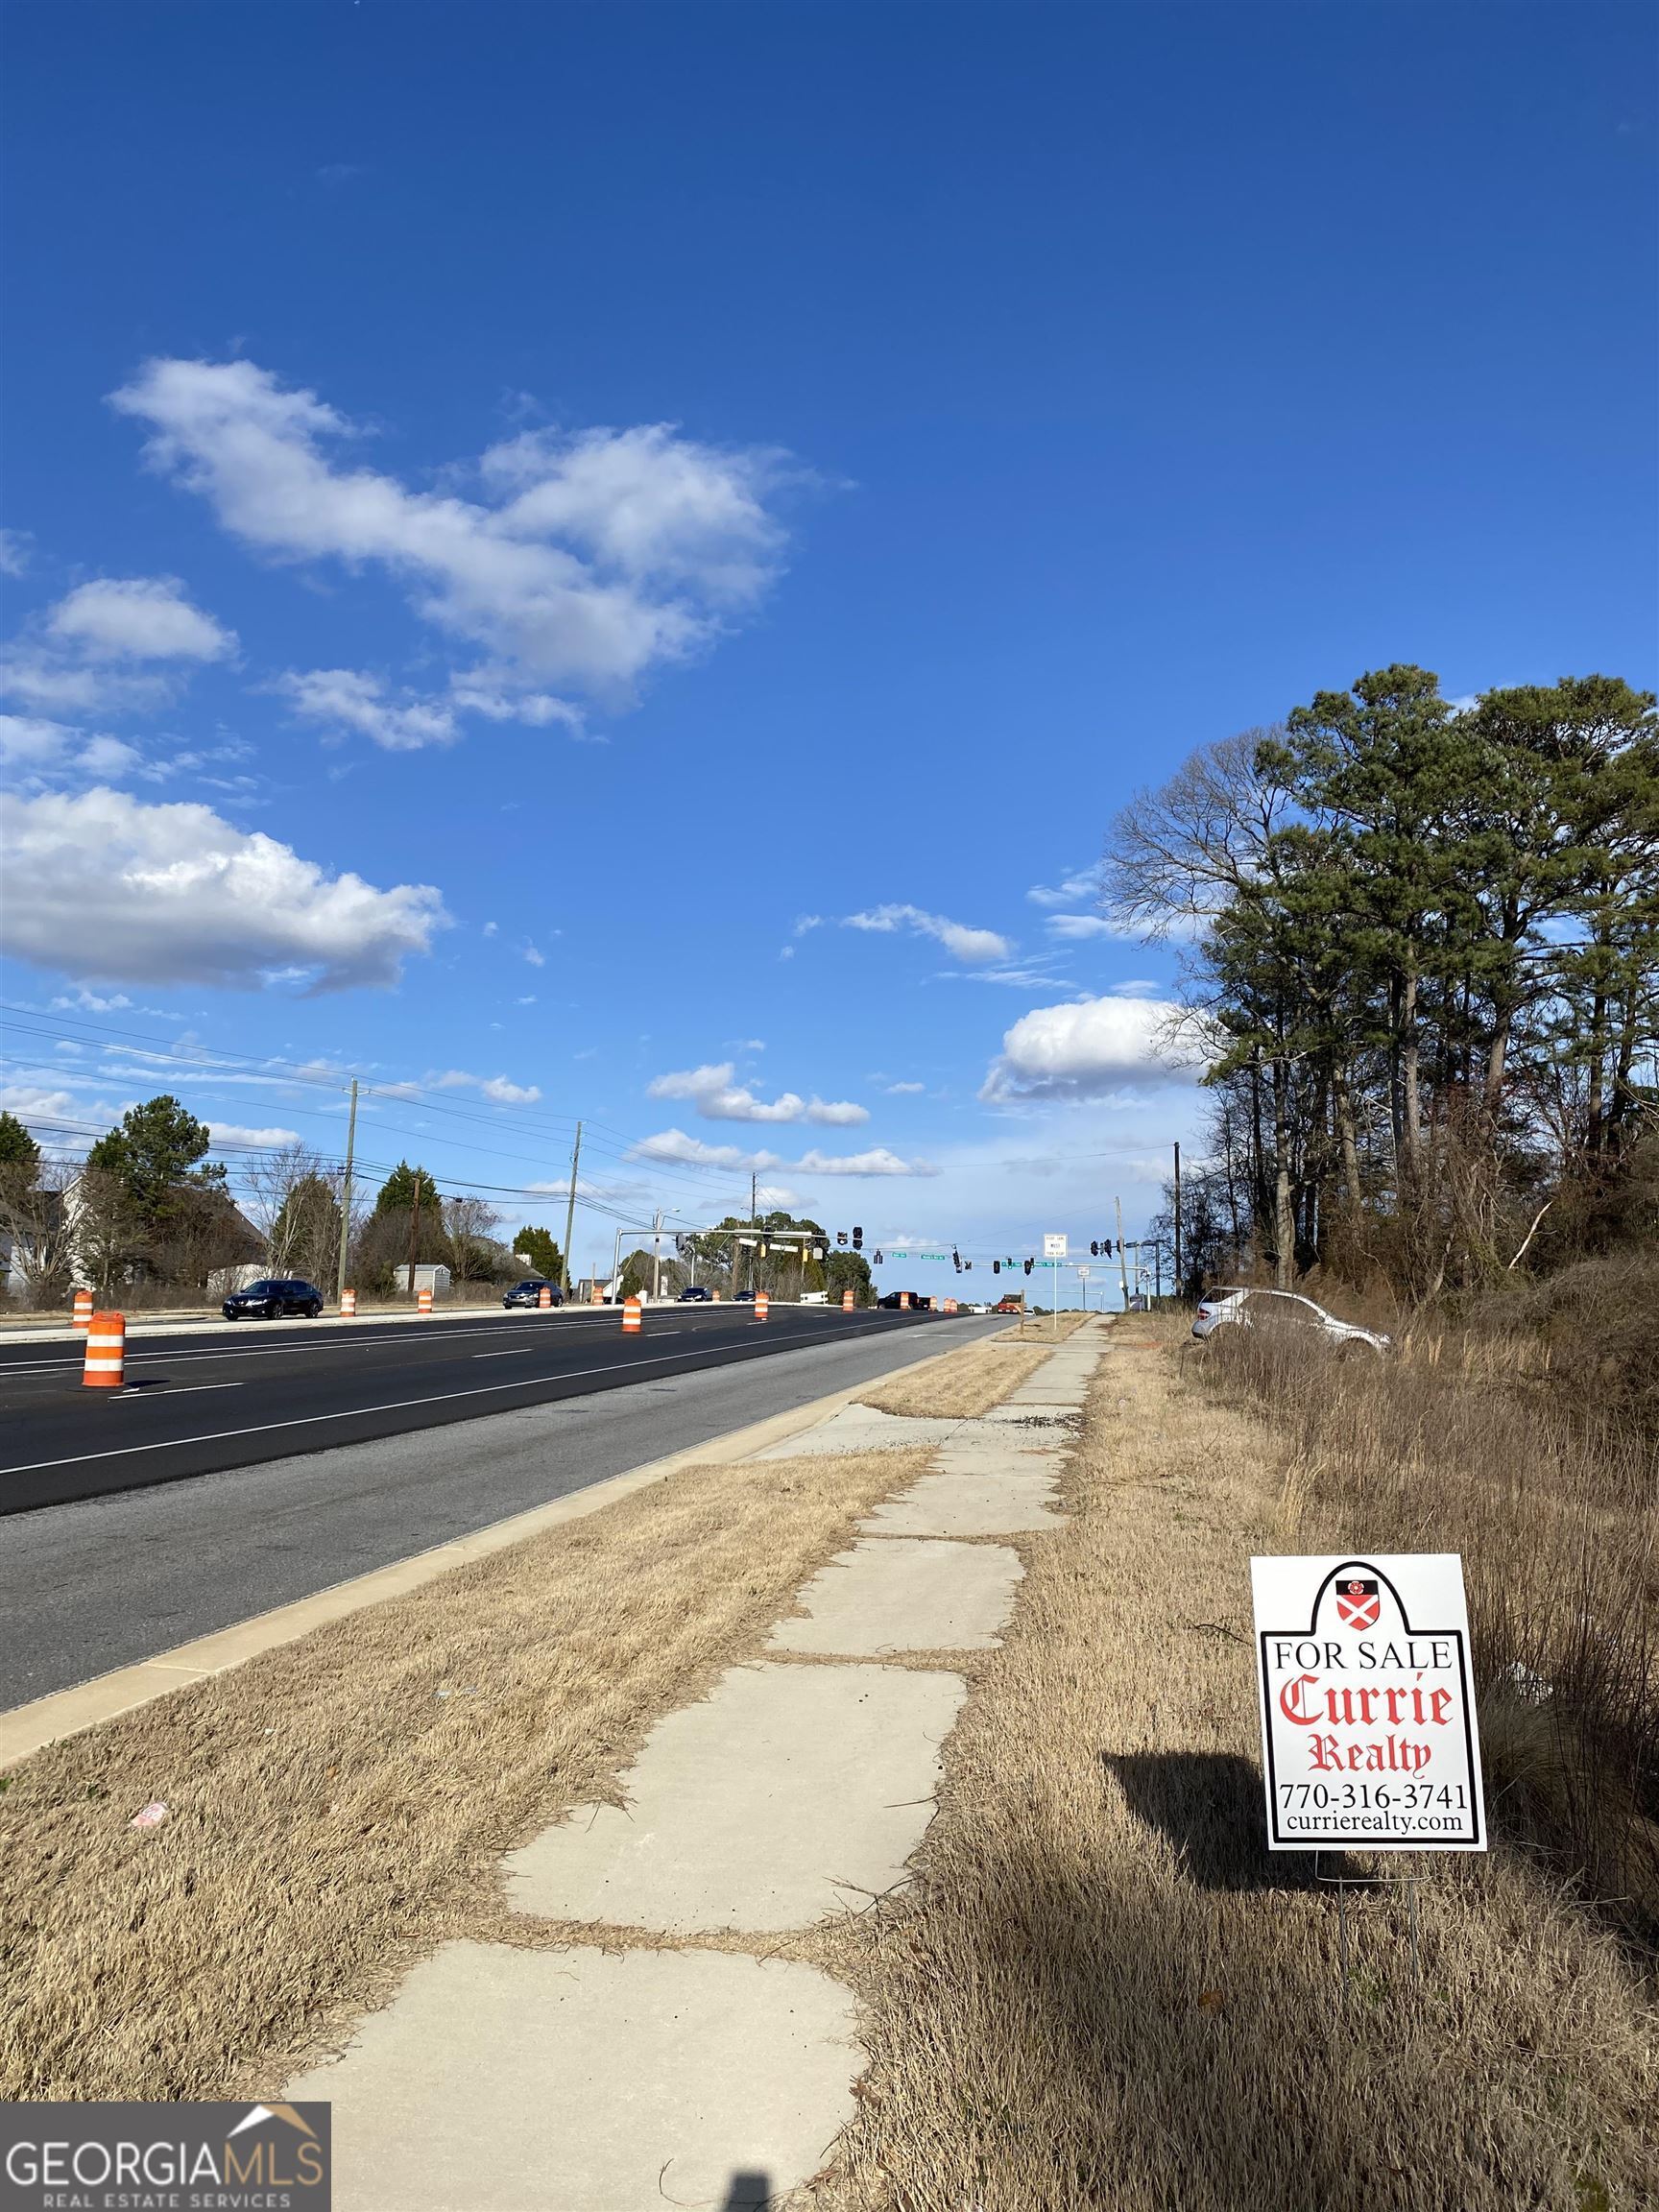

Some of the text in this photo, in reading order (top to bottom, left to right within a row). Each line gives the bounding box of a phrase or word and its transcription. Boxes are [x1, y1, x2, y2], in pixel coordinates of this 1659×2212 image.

[1273, 1641, 1453, 1670] FOR SALE
[1279, 1671, 1454, 1726] Currie
[1307, 1733, 1431, 1780] Realty
[1279, 1783, 1468, 1810] 770-316-3741
[1286, 1811, 1464, 1836] currierealty.com
